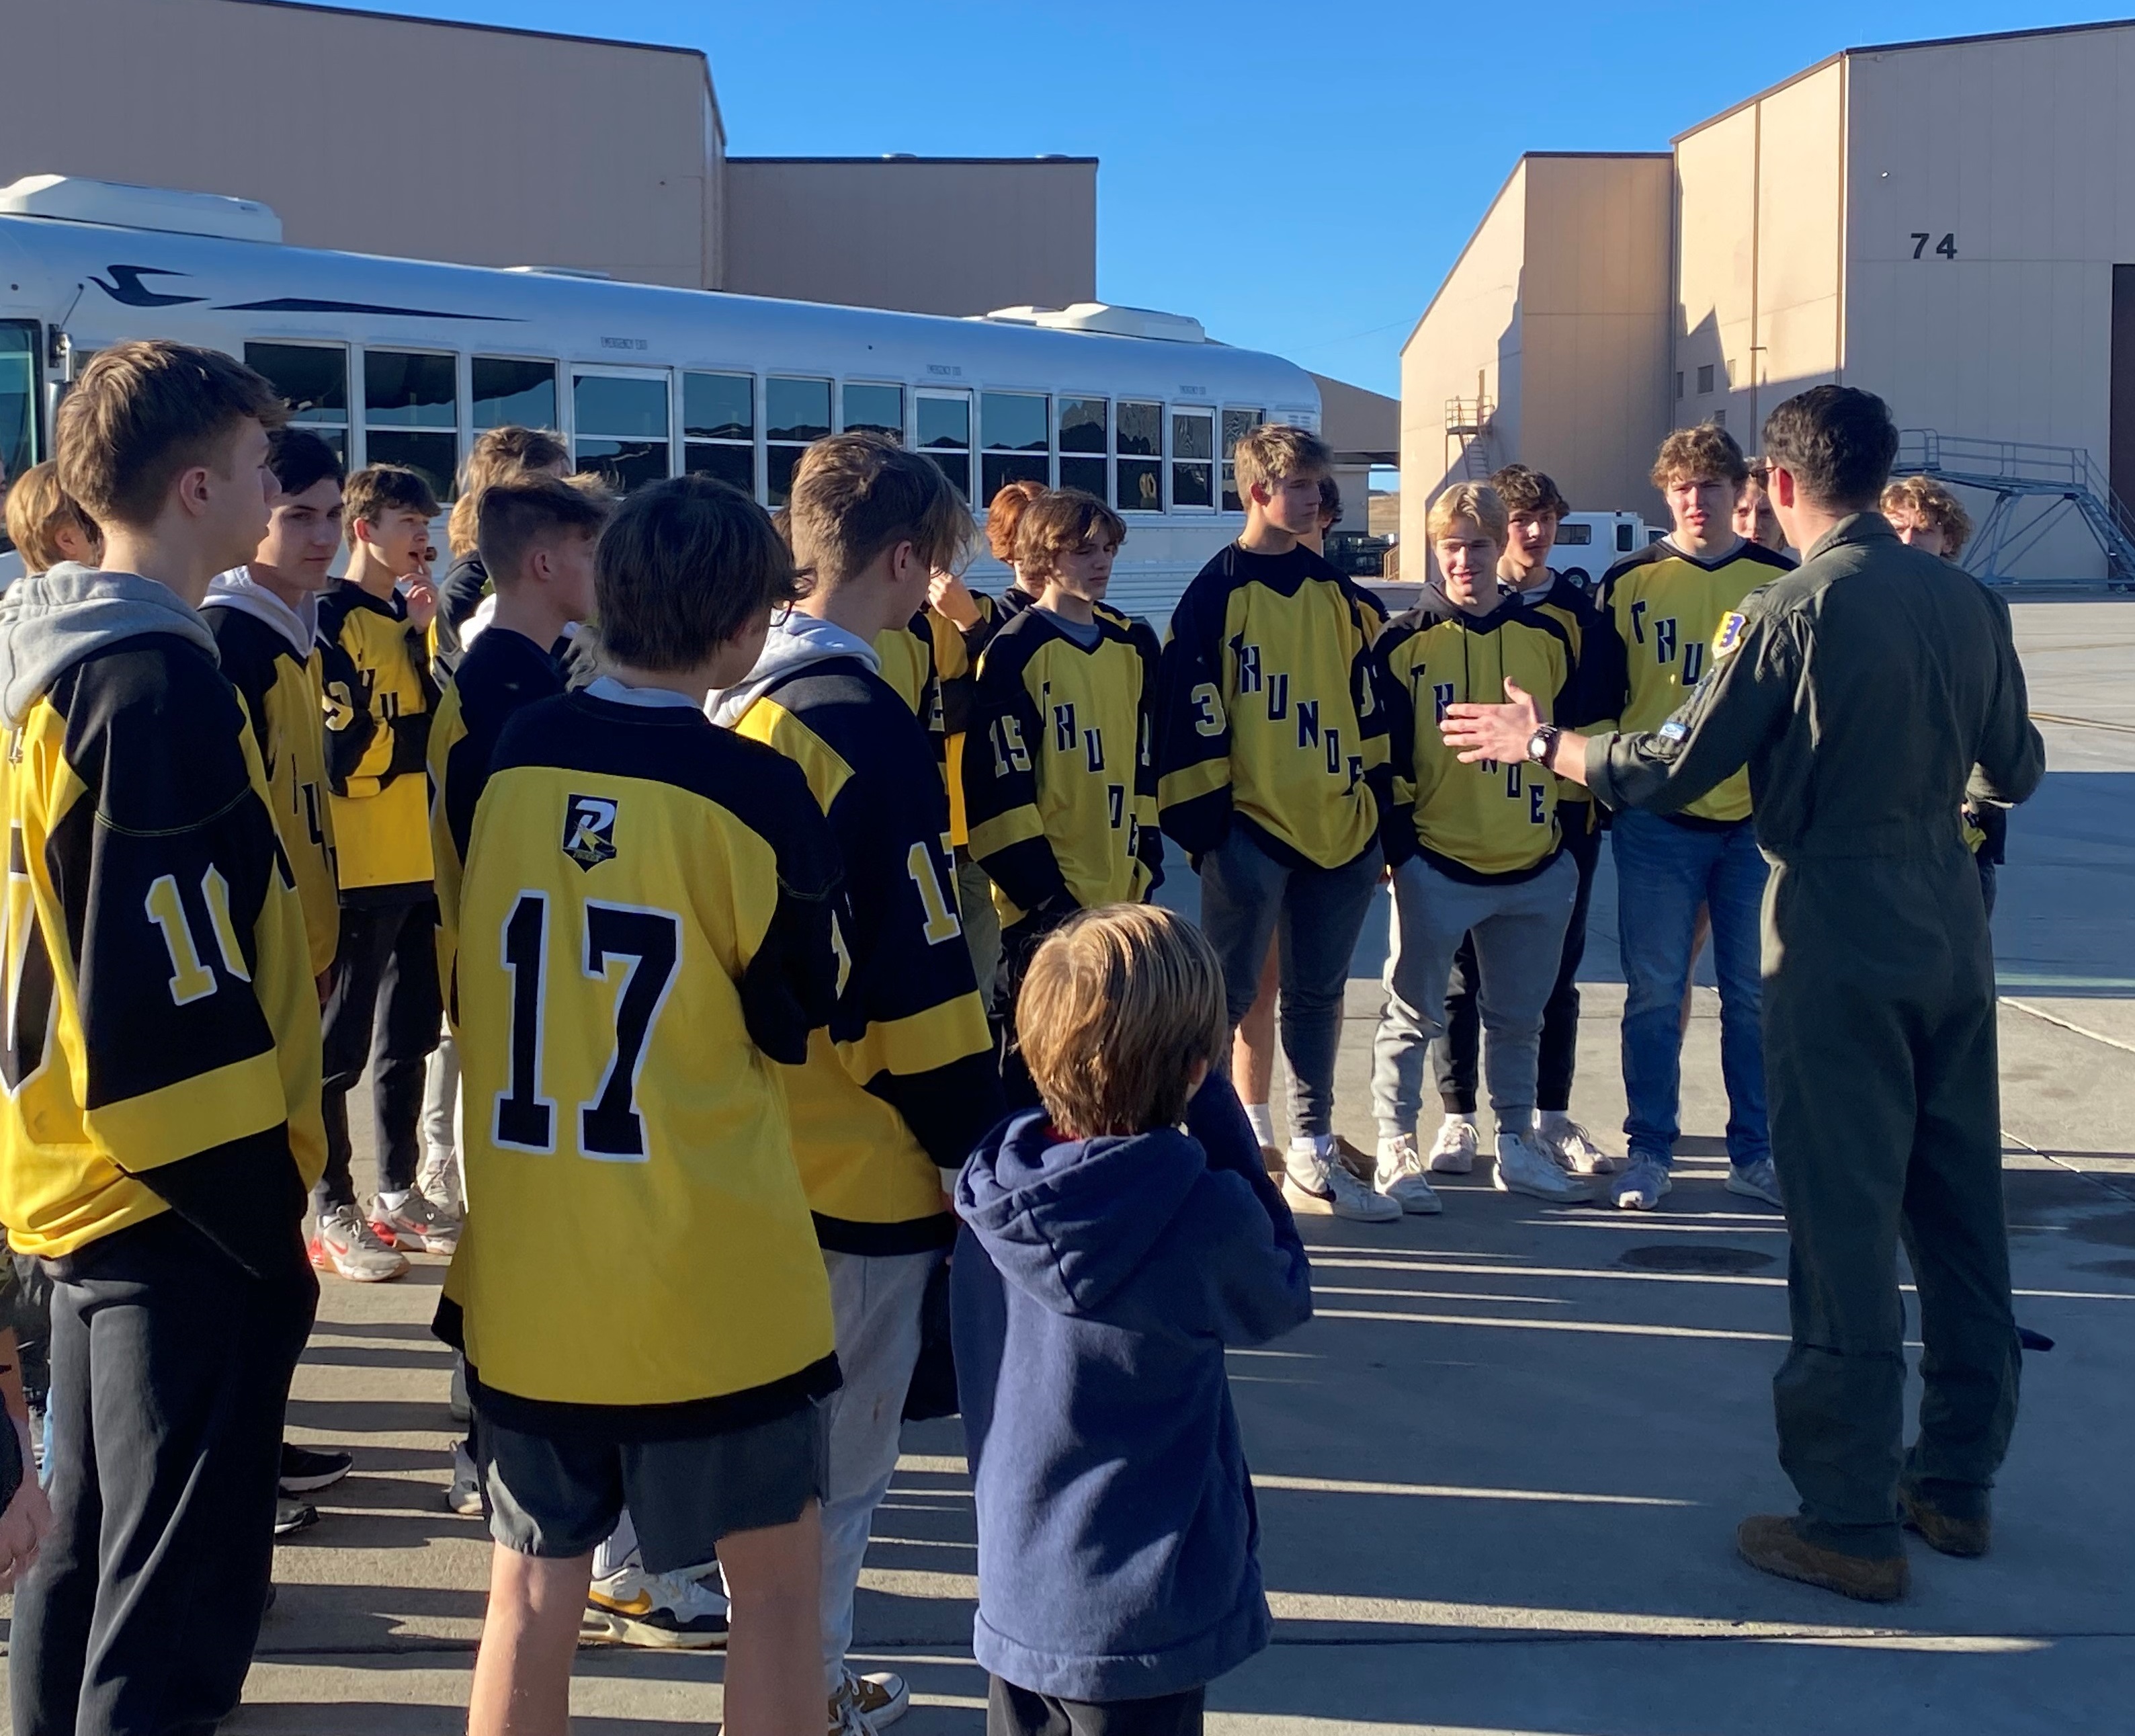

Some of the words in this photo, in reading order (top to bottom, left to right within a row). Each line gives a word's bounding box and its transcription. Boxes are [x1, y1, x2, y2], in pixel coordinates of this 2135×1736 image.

[1911, 233, 1958, 259] 74
[1191, 682, 1226, 737] 3
[989, 715, 1032, 778] 15
[491, 888, 683, 1163] 17
